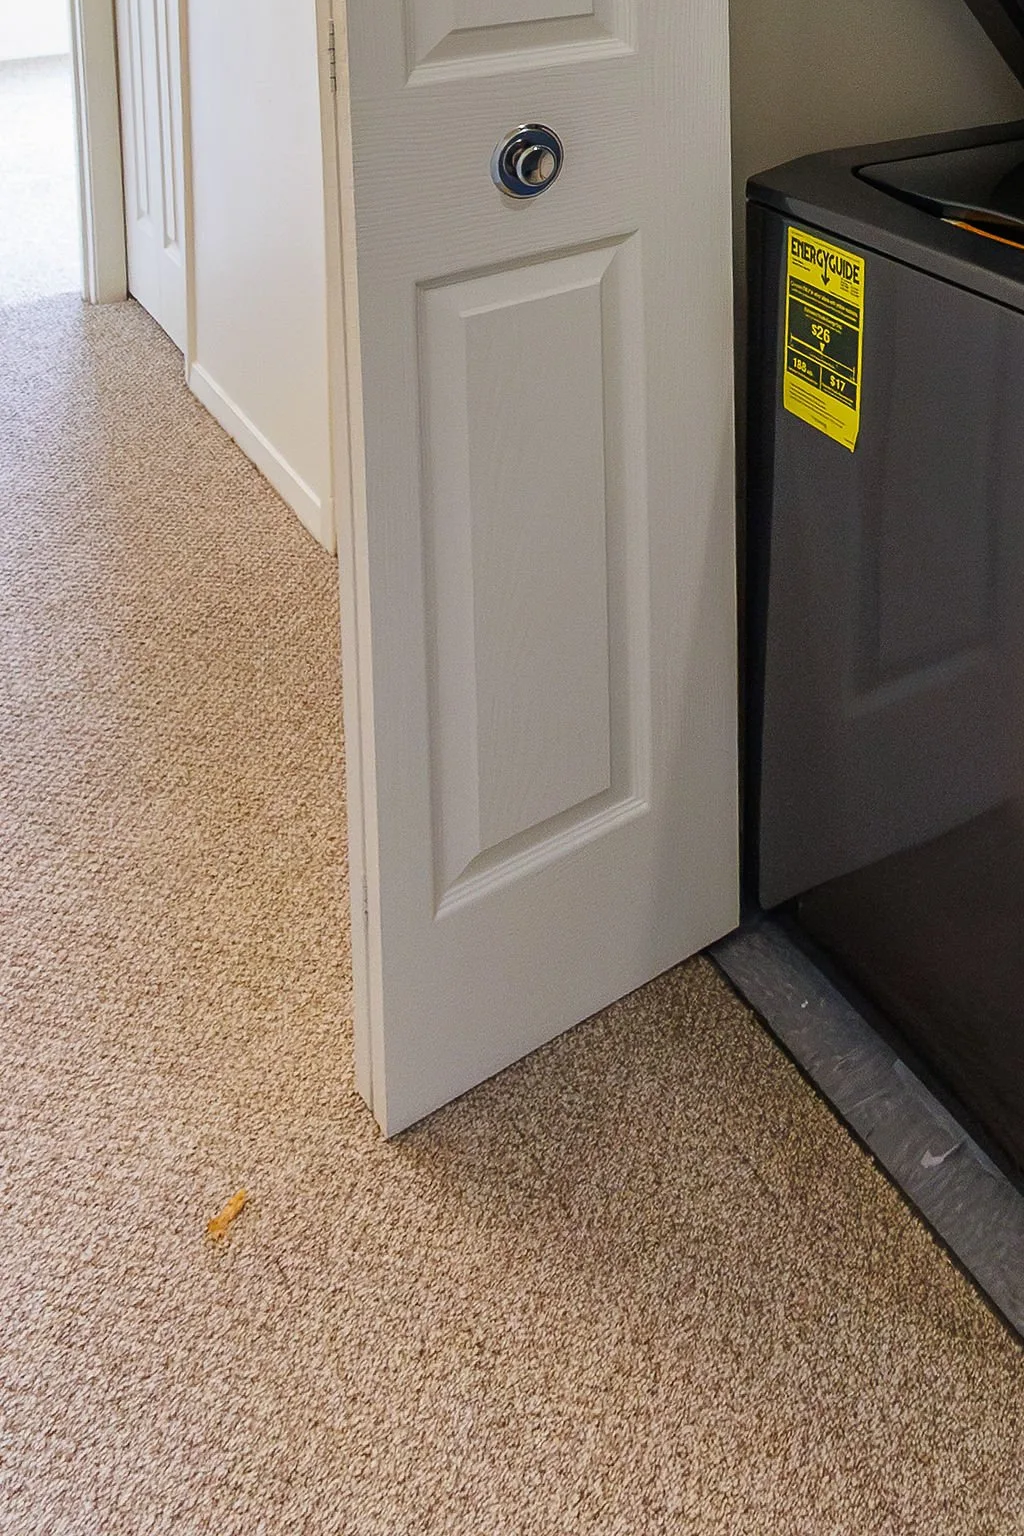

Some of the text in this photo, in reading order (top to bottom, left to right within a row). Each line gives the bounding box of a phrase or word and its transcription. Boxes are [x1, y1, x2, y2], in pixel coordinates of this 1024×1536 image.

[791, 236, 860, 285] ENERGYGUIDE
[811, 324, 830, 343] $26
[830, 375, 846, 392] $17
